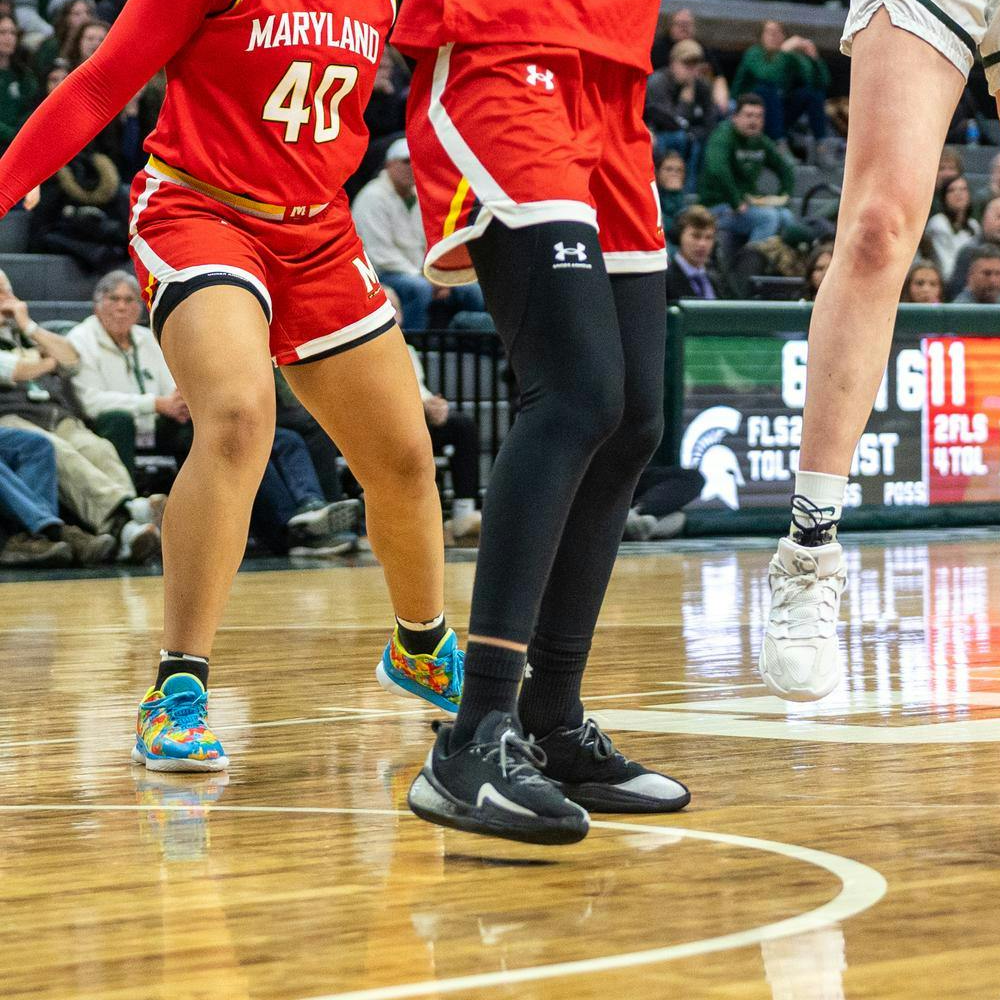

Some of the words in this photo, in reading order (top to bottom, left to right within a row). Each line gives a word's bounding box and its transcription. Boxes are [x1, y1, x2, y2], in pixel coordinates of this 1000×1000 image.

[245, 10, 381, 65] MARYLAND
[262, 60, 359, 144] 40
[928, 341, 966, 407] 11
